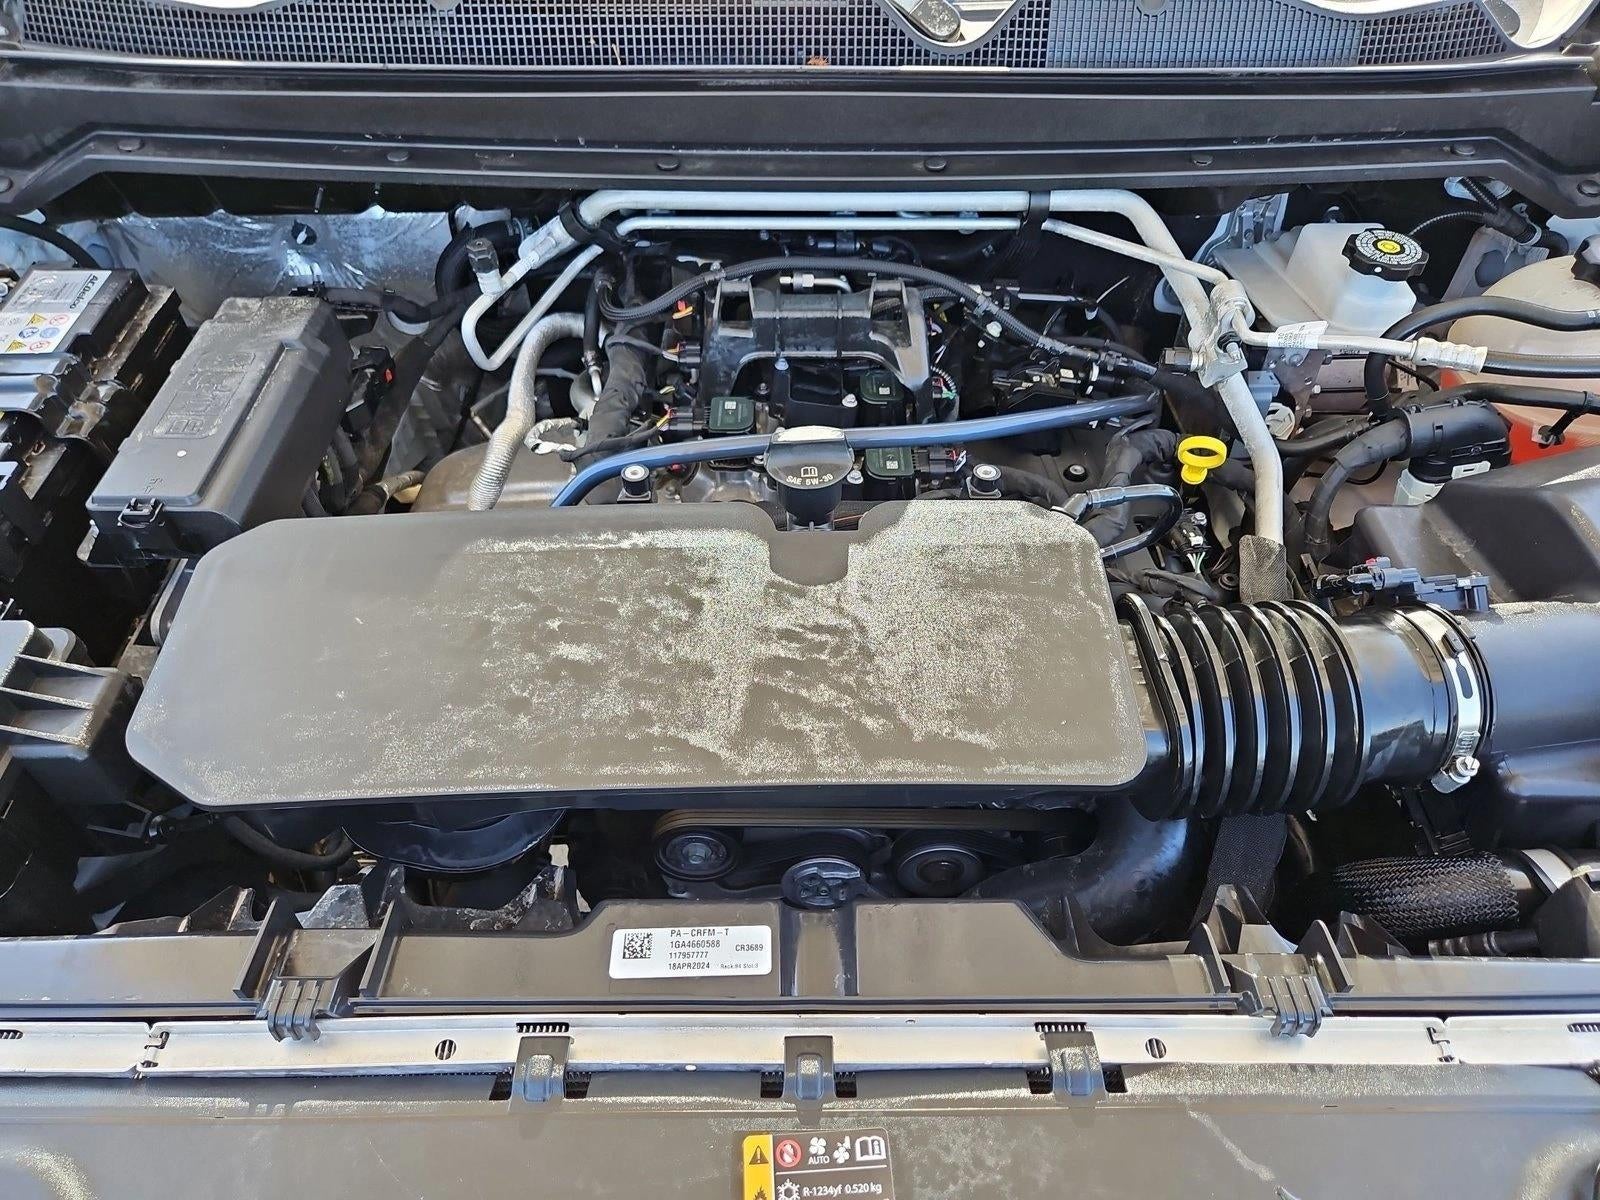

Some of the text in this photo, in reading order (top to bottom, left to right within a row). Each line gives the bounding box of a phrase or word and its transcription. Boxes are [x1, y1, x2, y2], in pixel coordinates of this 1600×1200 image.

[786, 473, 834, 486] SAE 5W-30
[670, 940, 720, 949] 1GA4660588
[735, 943, 764, 952] CR3689
[669, 951, 709, 960] 117957777
[668, 962, 710, 971] 18APR2024
[808, 1155, 830, 1165] AUTO
[802, 1182, 882, 1197] R-1234yf 0.520 kg
